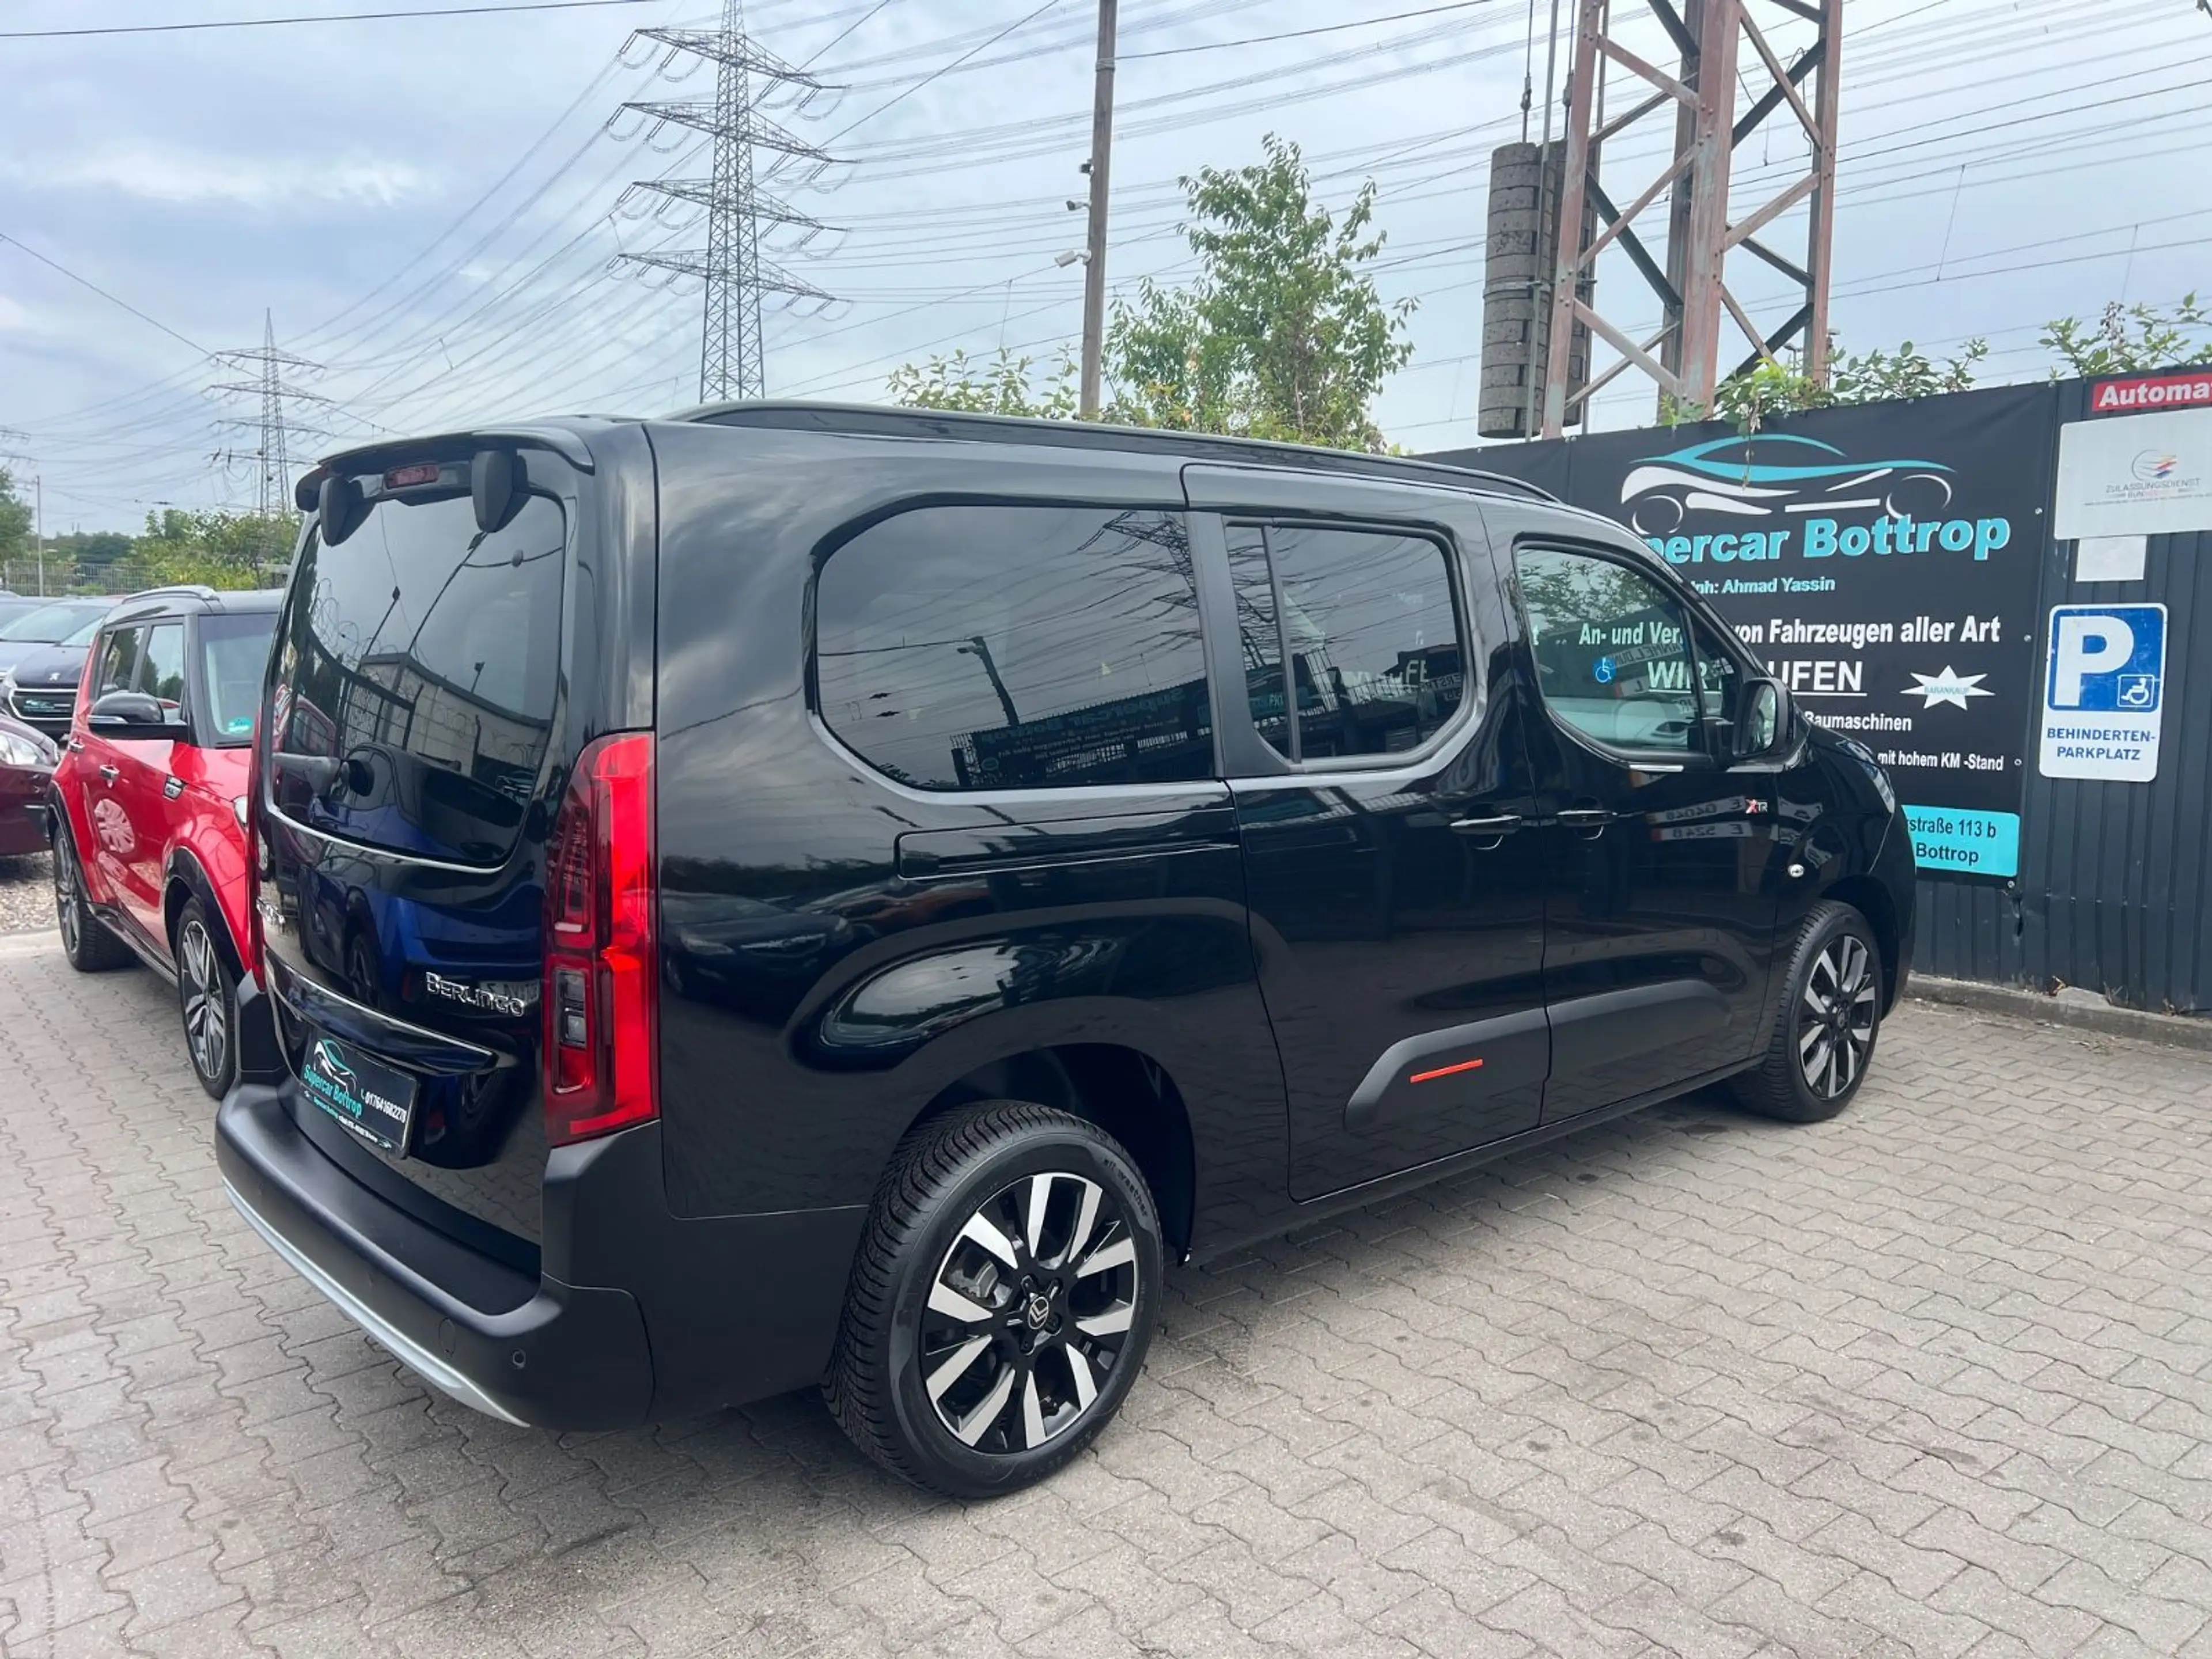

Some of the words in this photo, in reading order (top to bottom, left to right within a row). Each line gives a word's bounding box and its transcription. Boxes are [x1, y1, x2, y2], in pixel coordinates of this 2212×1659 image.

[2099, 382, 2212, 407] Automa
[1803, 514, 2011, 560] Bottrop
[1721, 578, 1777, 594] Ahmad
[1782, 576, 1836, 592] Yassin
[1578, 622, 1607, 645] An-
[1612, 622, 1643, 645] und
[1649, 622, 1683, 644] Ver
[1769, 618, 1893, 649] Fahrzeugen
[1900, 616, 1955, 642] aller
[1960, 615, 2001, 643] Art
[2054, 615, 2134, 707] P
[1767, 660, 1863, 691] UFEN
[2047, 727, 2156, 743] BEHINDERTEN-
[1898, 751, 1938, 767] hohem
[1941, 752, 1960, 768] KM
[2056, 746, 2141, 761] PARKPLATZ
[1907, 816, 1953, 835] straße
[1959, 818, 1982, 838] 113
[1987, 821, 1997, 839] b
[1916, 842, 1979, 866] Bottrop
